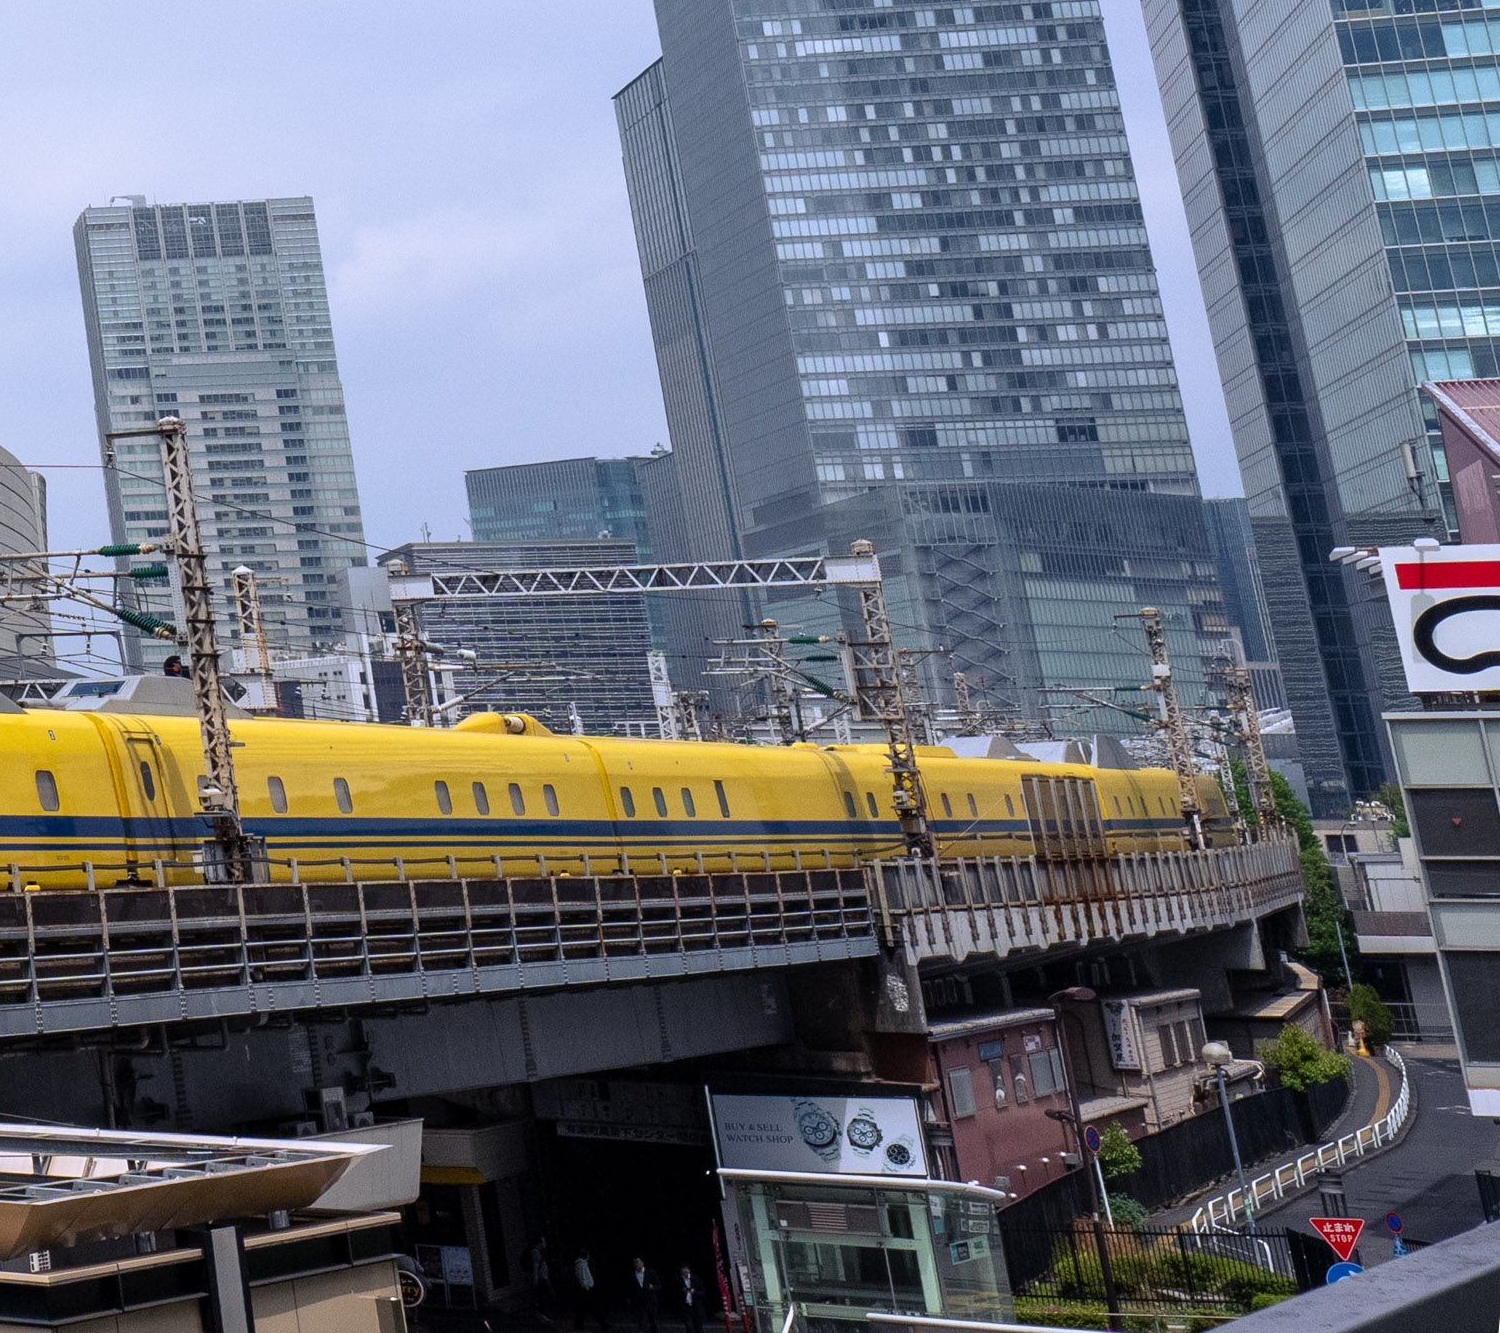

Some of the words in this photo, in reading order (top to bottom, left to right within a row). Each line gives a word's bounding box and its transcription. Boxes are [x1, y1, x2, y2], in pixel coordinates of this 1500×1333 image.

[724, 1123, 748, 1131] BUY
[757, 1124, 784, 1132] SELL
[727, 1135, 764, 1143] WATCH
[766, 1136, 794, 1144] SHOP
[1323, 1222, 1356, 1233] 止まれ
[1329, 1234, 1353, 1243] STOP
